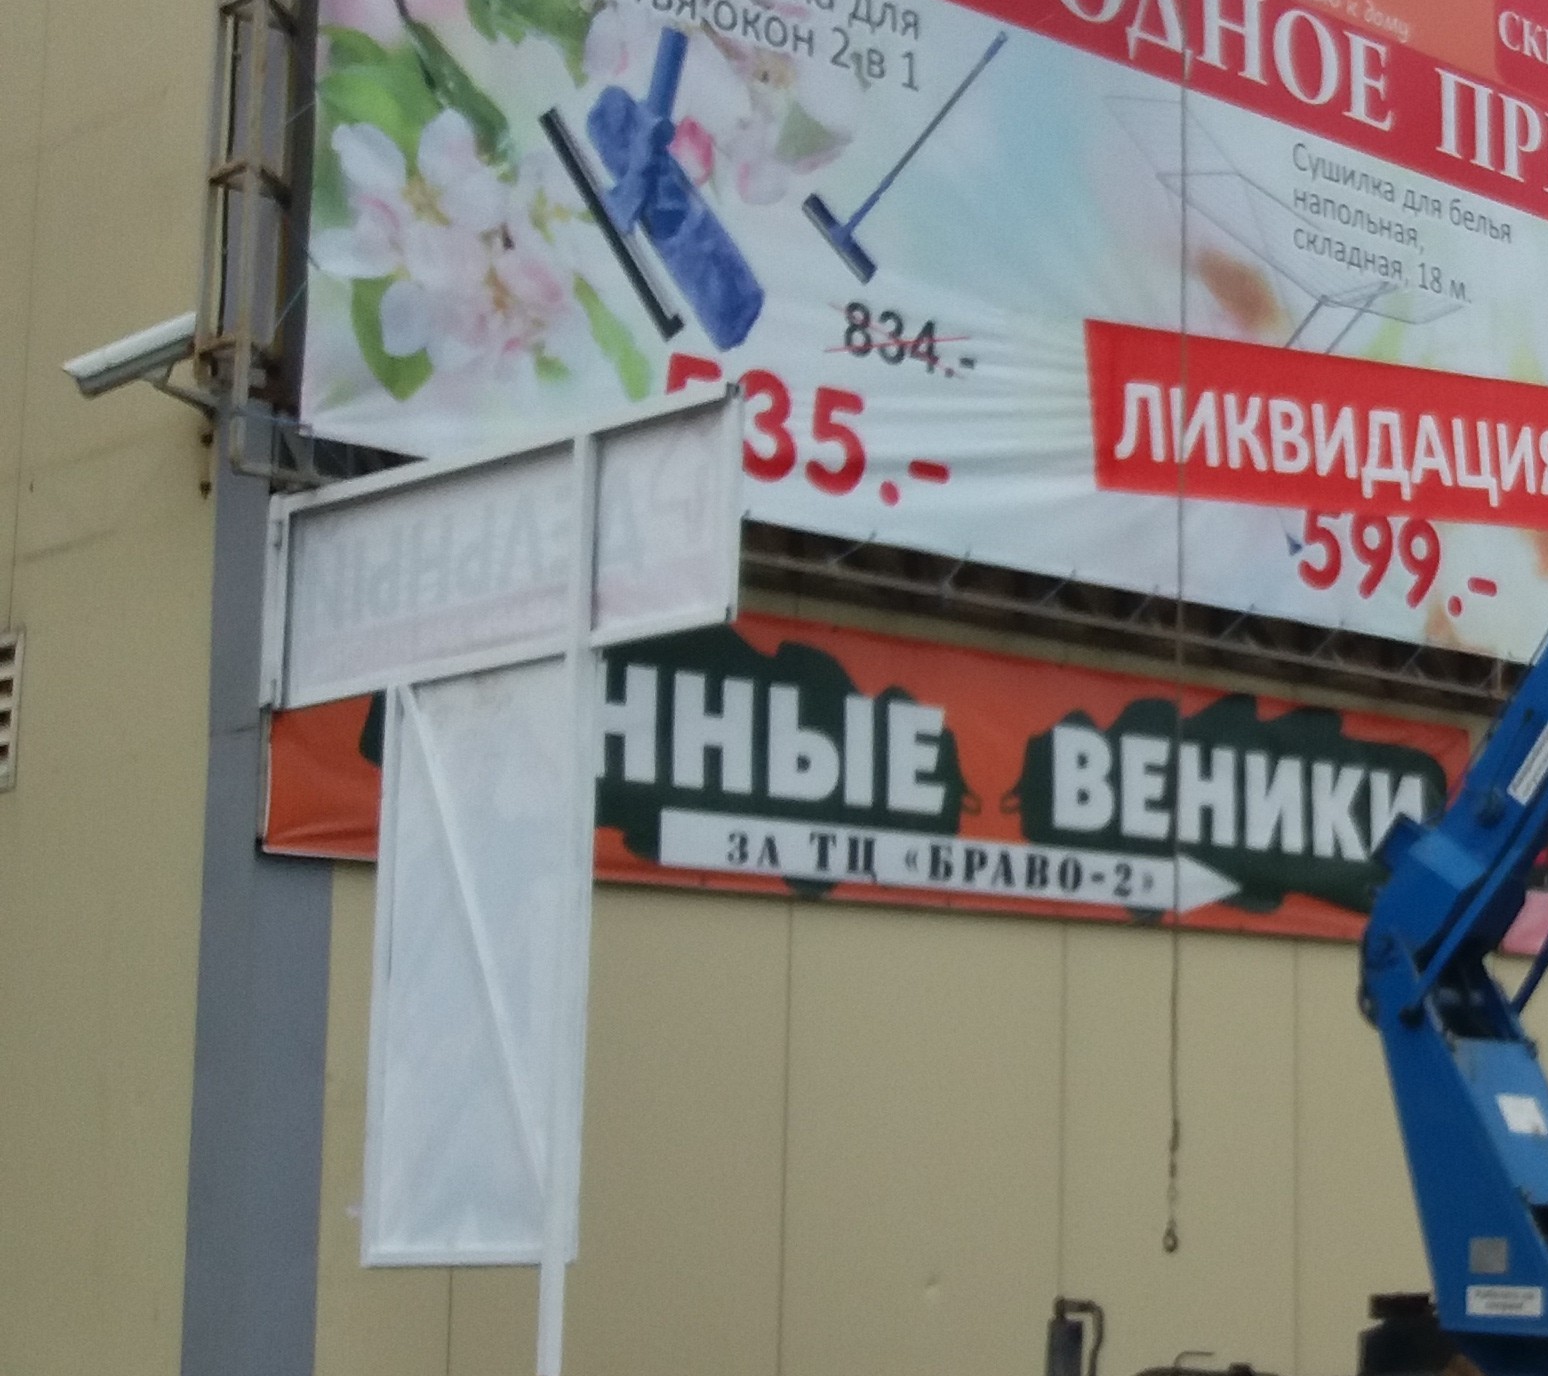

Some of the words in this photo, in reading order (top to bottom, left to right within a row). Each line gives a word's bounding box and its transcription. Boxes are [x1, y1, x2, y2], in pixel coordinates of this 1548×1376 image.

[712, 0, 815, 57] окон
[831, 26, 850, 61] 2
[866, 48, 886, 78] в
[902, 53, 920, 90] 1
[1292, 143, 1396, 202] Сушилка
[1402, 189, 1442, 219] для
[1450, 199, 1512, 245] белья
[1294, 187, 1425, 255] напольная,
[1418, 262, 1443, 292] 18
[667, 352, 951, 506] 35.-
[601, 658, 945, 816] ННЫЕ
[1052, 722, 1425, 865] ВЕНИКИ
[726, 831, 781, 869] ЗА
[811, 832, 878, 883] ТЦ
